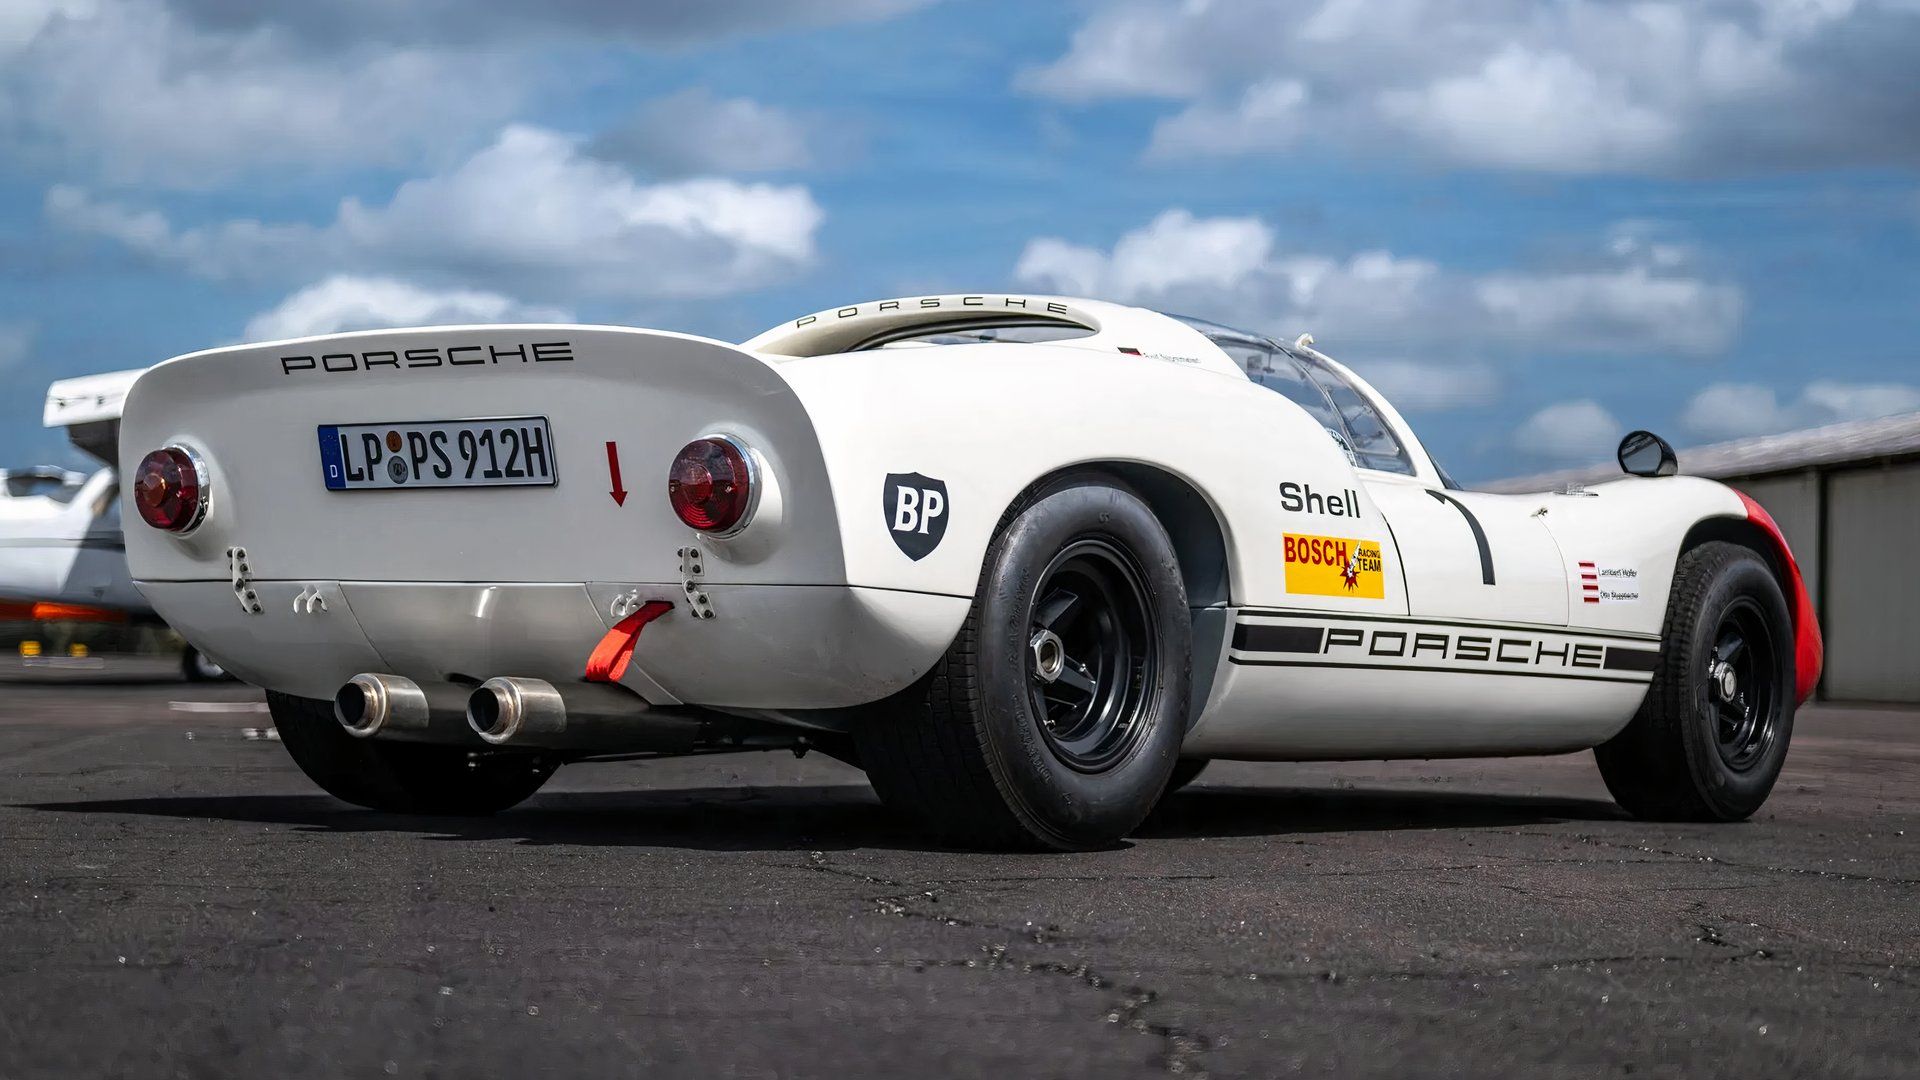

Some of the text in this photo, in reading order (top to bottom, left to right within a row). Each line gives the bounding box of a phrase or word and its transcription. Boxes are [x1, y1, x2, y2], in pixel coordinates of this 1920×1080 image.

[797, 296, 1067, 328] PORSCHE
[280, 341, 574, 375] PORSCHE
[329, 464, 338, 478] D
[340, 427, 548, 482] LP PS 912H
[893, 485, 944, 534] BP
[1279, 481, 1361, 518] Shell
[1284, 536, 1347, 567] BOSCH
[1358, 548, 1381, 559] RACING
[1358, 558, 1382, 572] TEAM
[1323, 628, 1603, 669] PORSCHE
